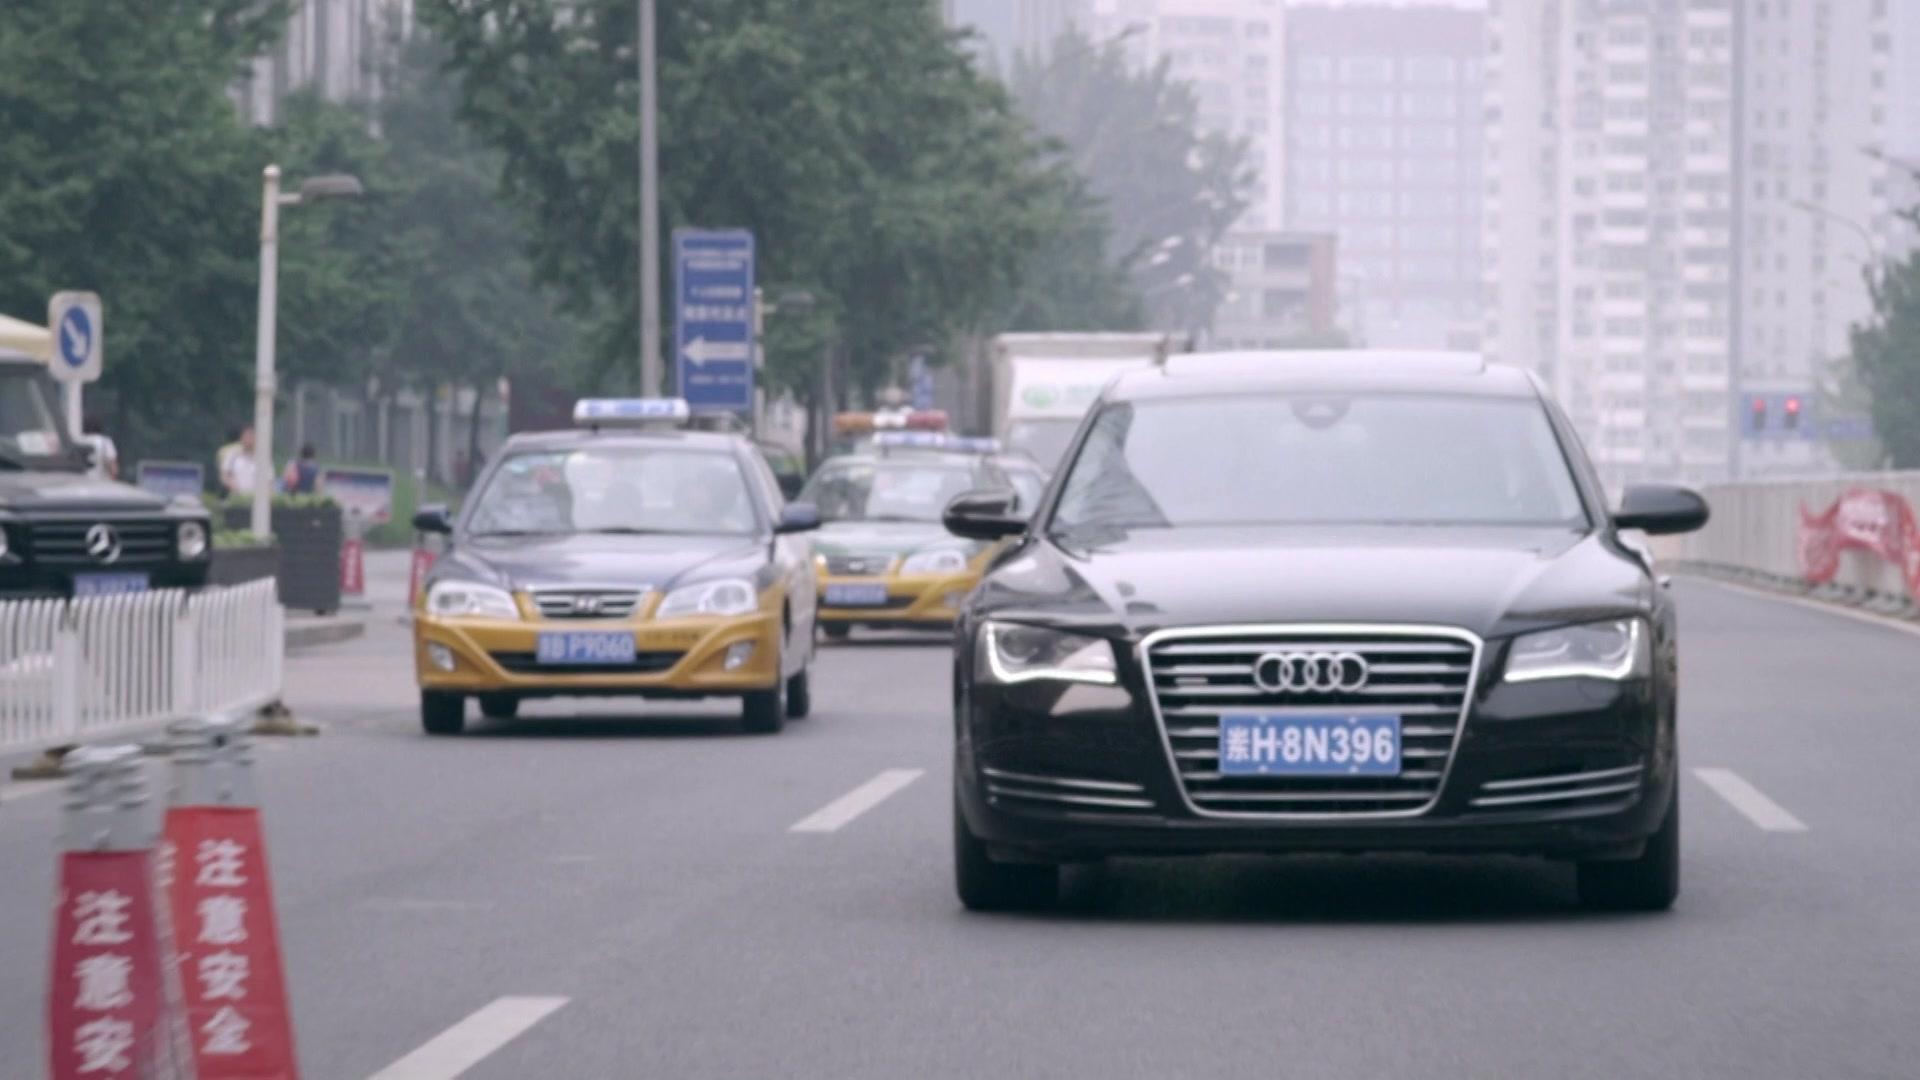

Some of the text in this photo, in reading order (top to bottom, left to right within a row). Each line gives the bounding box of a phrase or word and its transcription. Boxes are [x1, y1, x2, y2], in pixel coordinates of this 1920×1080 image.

[71, 888, 135, 1080] 注意安
[195, 838, 251, 1054] 注意安全
